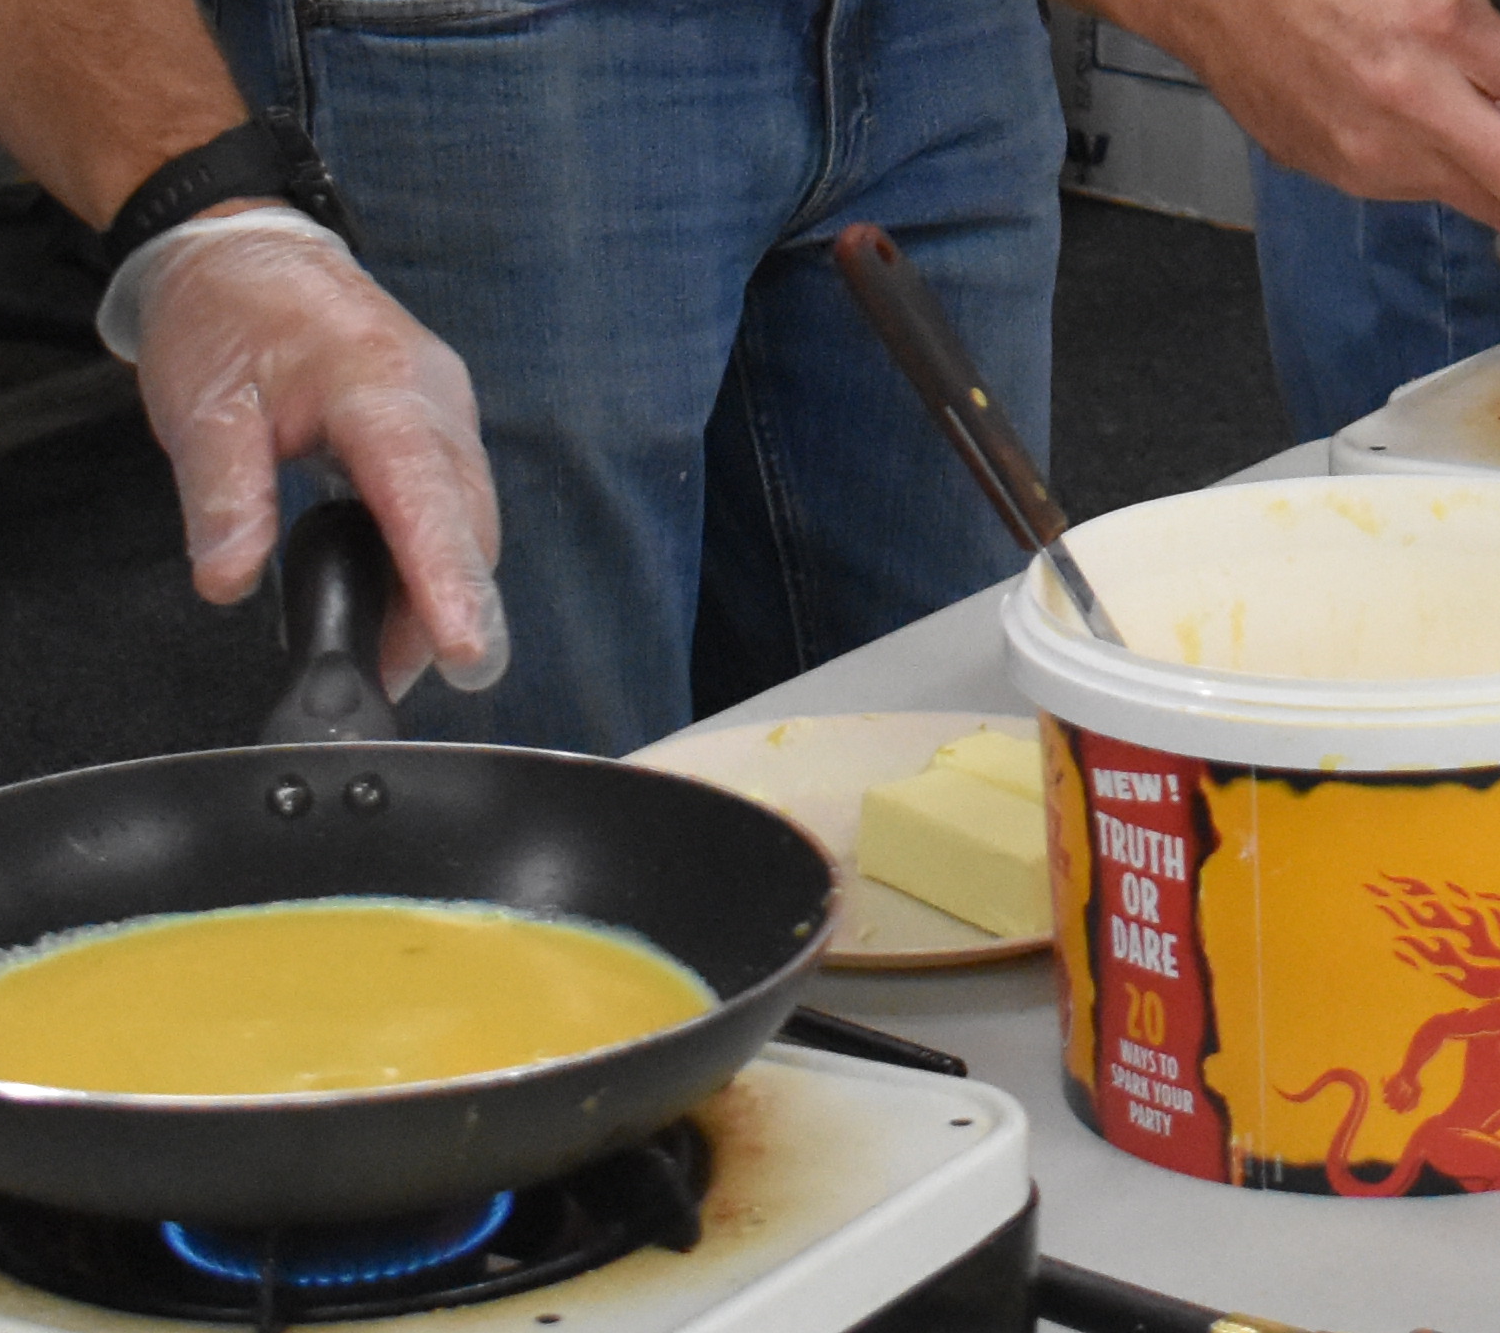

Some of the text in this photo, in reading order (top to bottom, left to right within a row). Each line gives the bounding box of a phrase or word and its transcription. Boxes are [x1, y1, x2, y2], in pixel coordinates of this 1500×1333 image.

[1095, 811, 1186, 881] TRUTH
[1121, 872, 1160, 924] OR
[1111, 914, 1179, 978] DARE
[1124, 981, 1167, 1047] 20
[1119, 1038, 1179, 1080] WAYS TO
[1111, 1062, 1194, 1114] SPARK YOUR
[1129, 1102, 1172, 1137] PARTY
